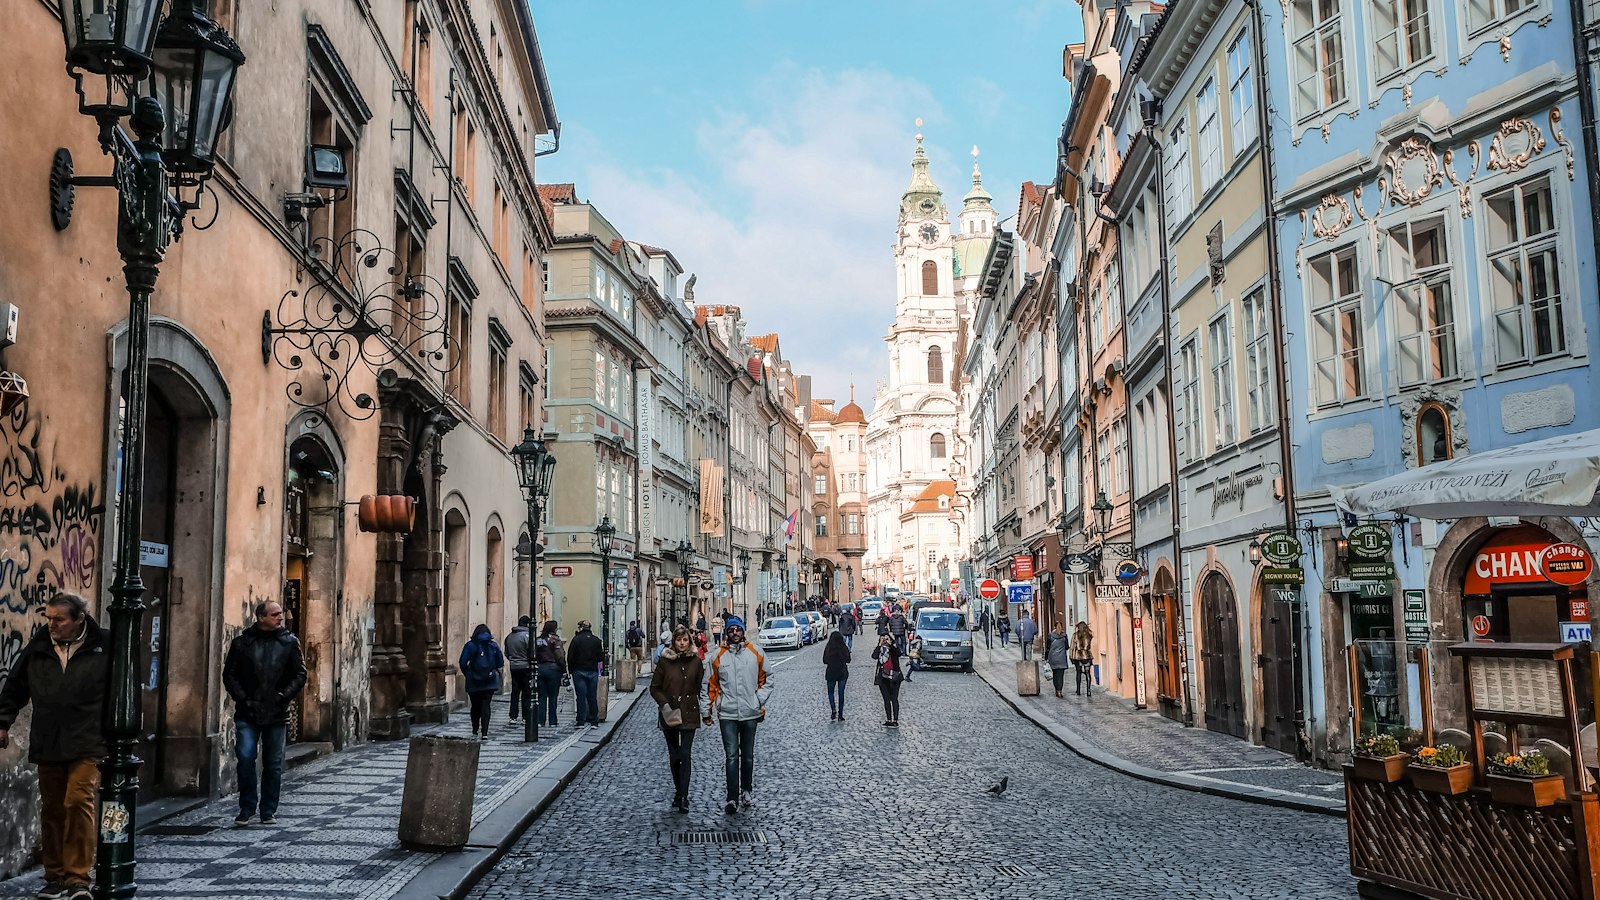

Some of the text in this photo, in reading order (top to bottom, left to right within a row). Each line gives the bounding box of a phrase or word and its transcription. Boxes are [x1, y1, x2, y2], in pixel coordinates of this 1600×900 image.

[640, 387, 648, 432] BALTHASAR
[642, 512, 650, 544] DESIGN
[1546, 546, 1584, 559] change
[1096, 586, 1130, 597] CHANGE
[1366, 584, 1386, 596] WC
[1277, 591, 1296, 601] WC
[1352, 604, 1380, 614] TOURIST
[1405, 612, 1427, 620] HOSTEL
